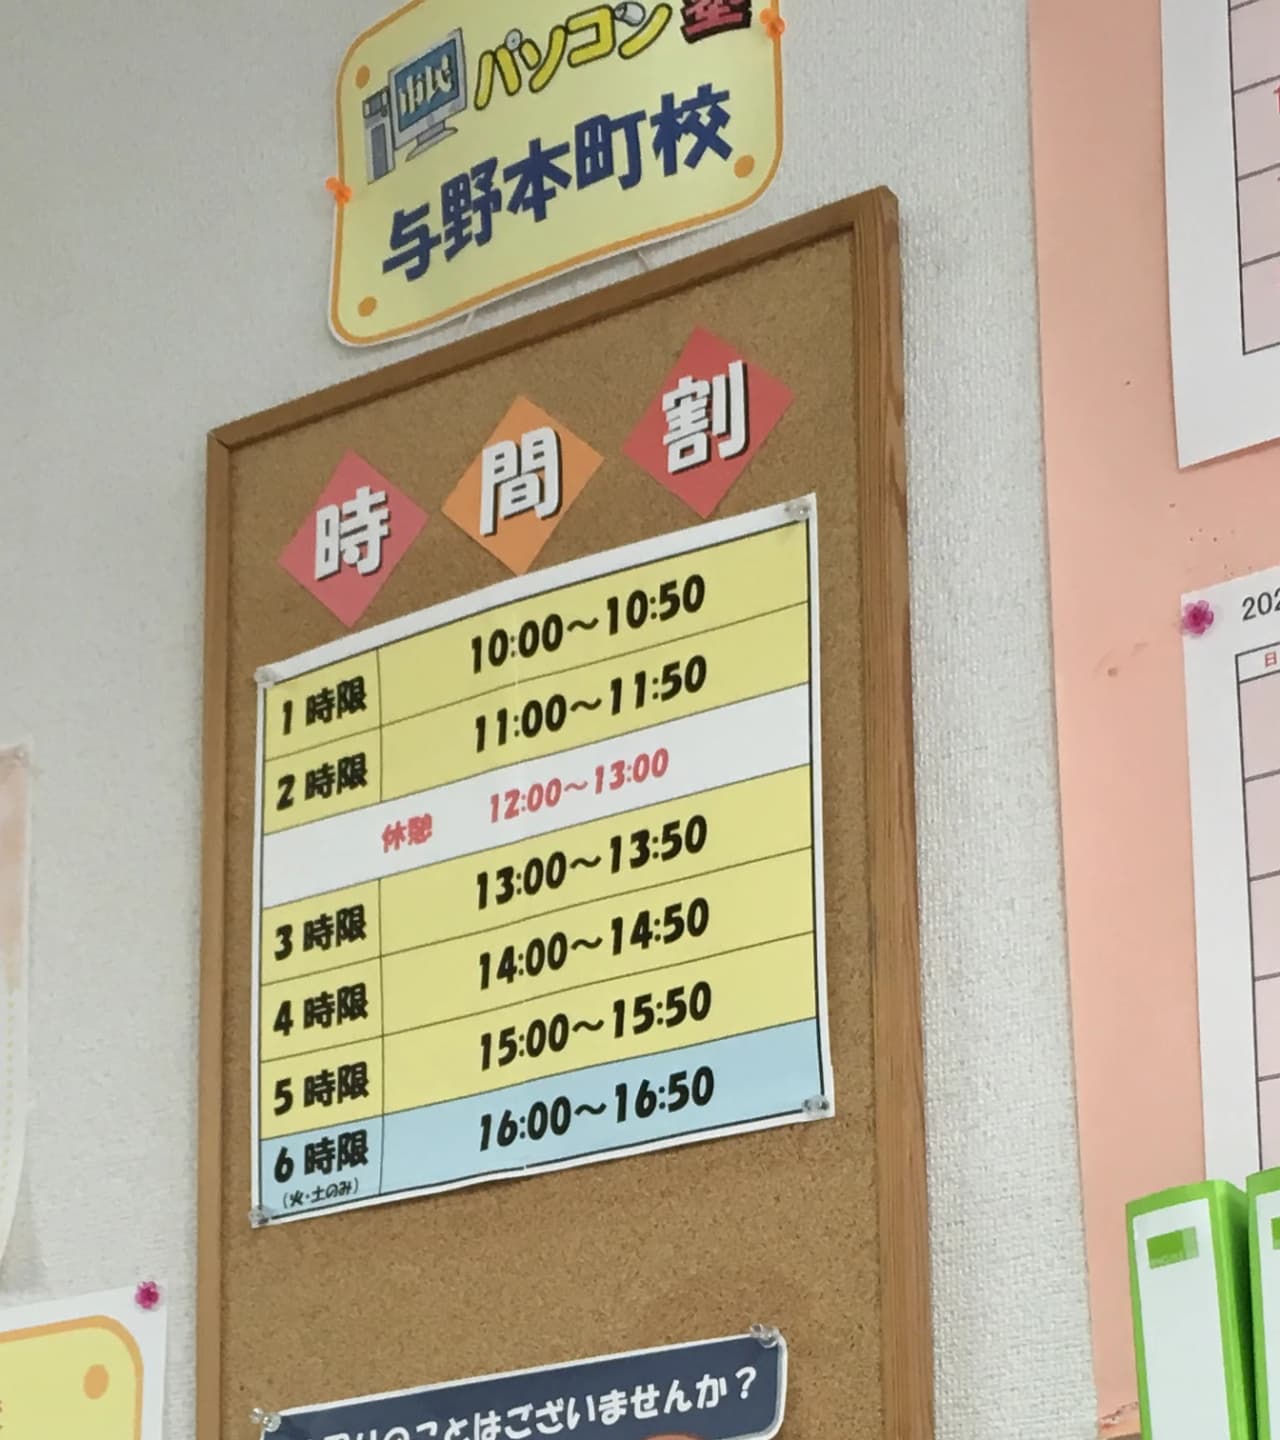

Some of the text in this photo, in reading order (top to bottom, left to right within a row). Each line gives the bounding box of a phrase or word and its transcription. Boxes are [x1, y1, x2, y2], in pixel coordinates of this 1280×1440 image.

[382, 83, 734, 282] 与野本町校
[381, 814, 434, 854] 休憩
